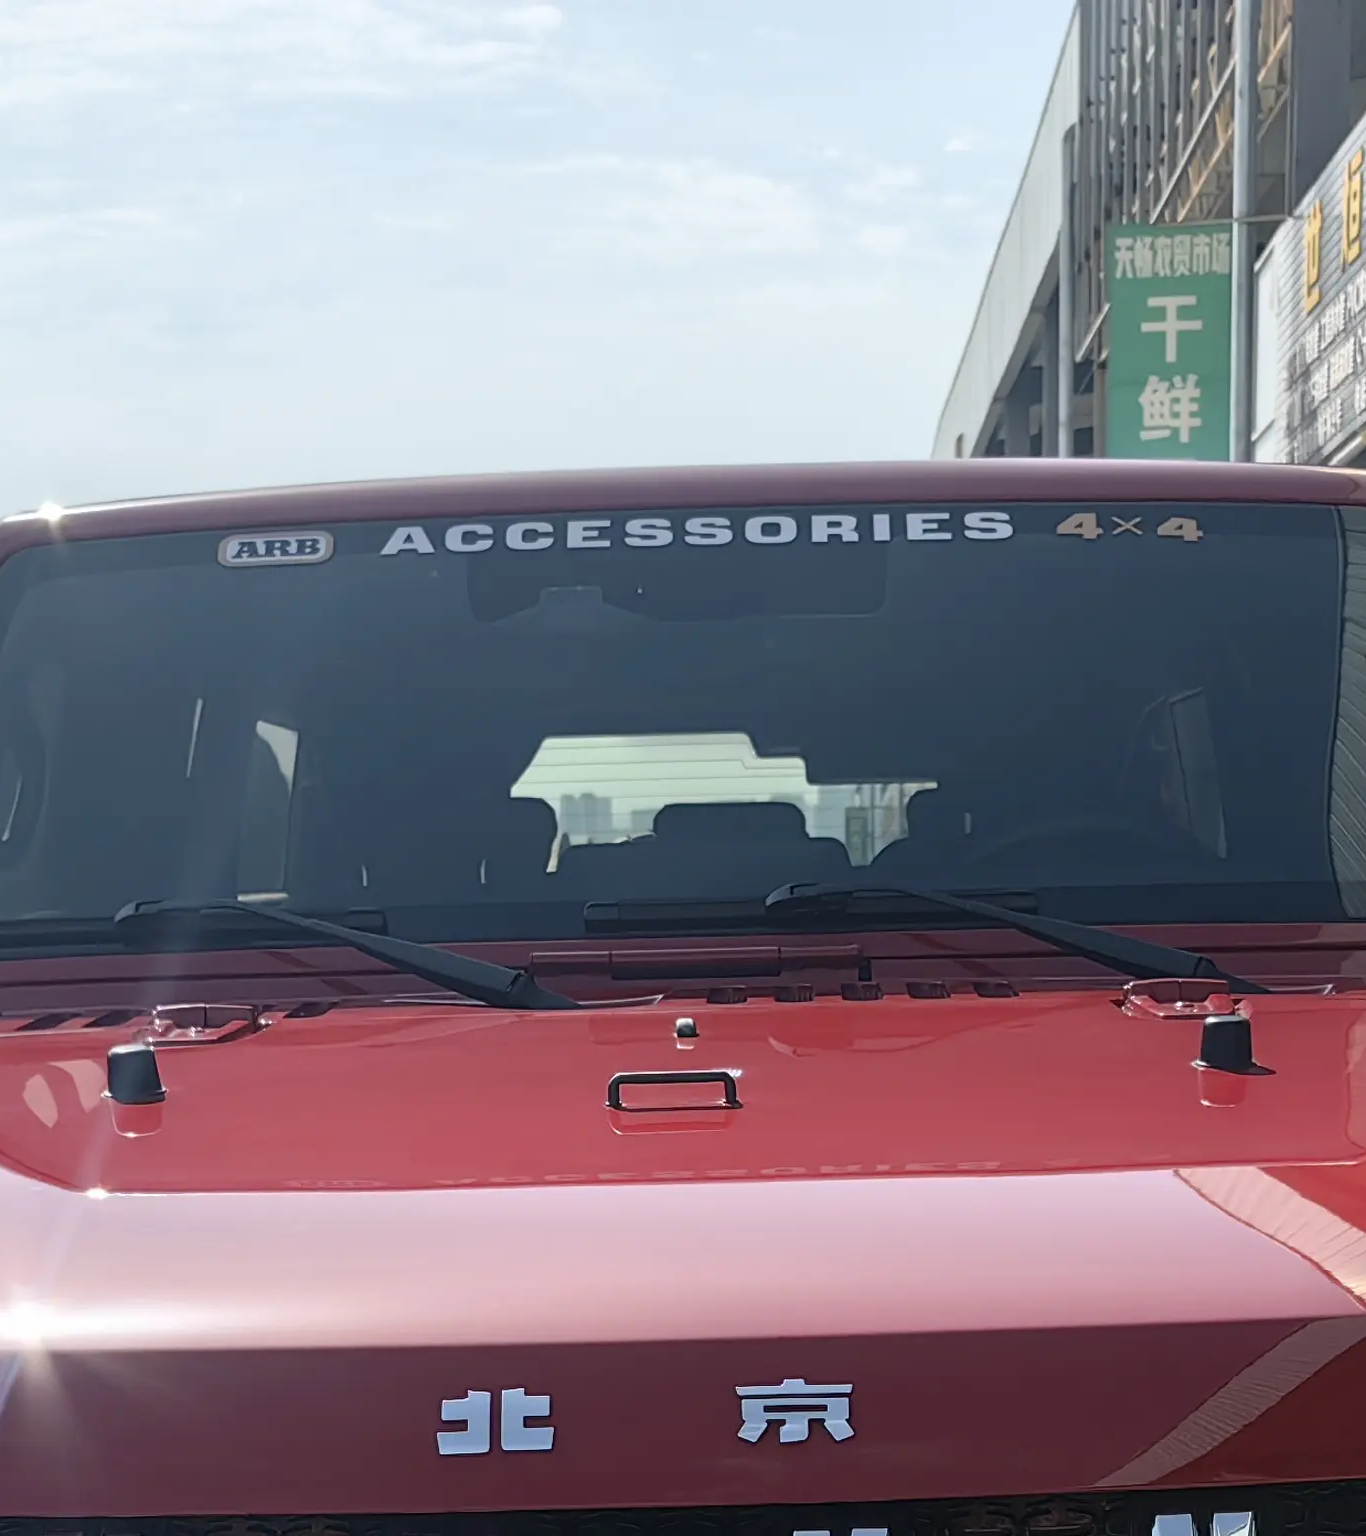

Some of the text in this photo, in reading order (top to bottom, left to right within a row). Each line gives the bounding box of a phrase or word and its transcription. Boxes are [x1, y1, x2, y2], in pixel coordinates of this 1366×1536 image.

[1138, 295, 1203, 444] 干鲜
[232, 537, 321, 560] ARB
[380, 511, 1014, 556] ACCESSORIES
[436, 1378, 855, 1456] 北京
